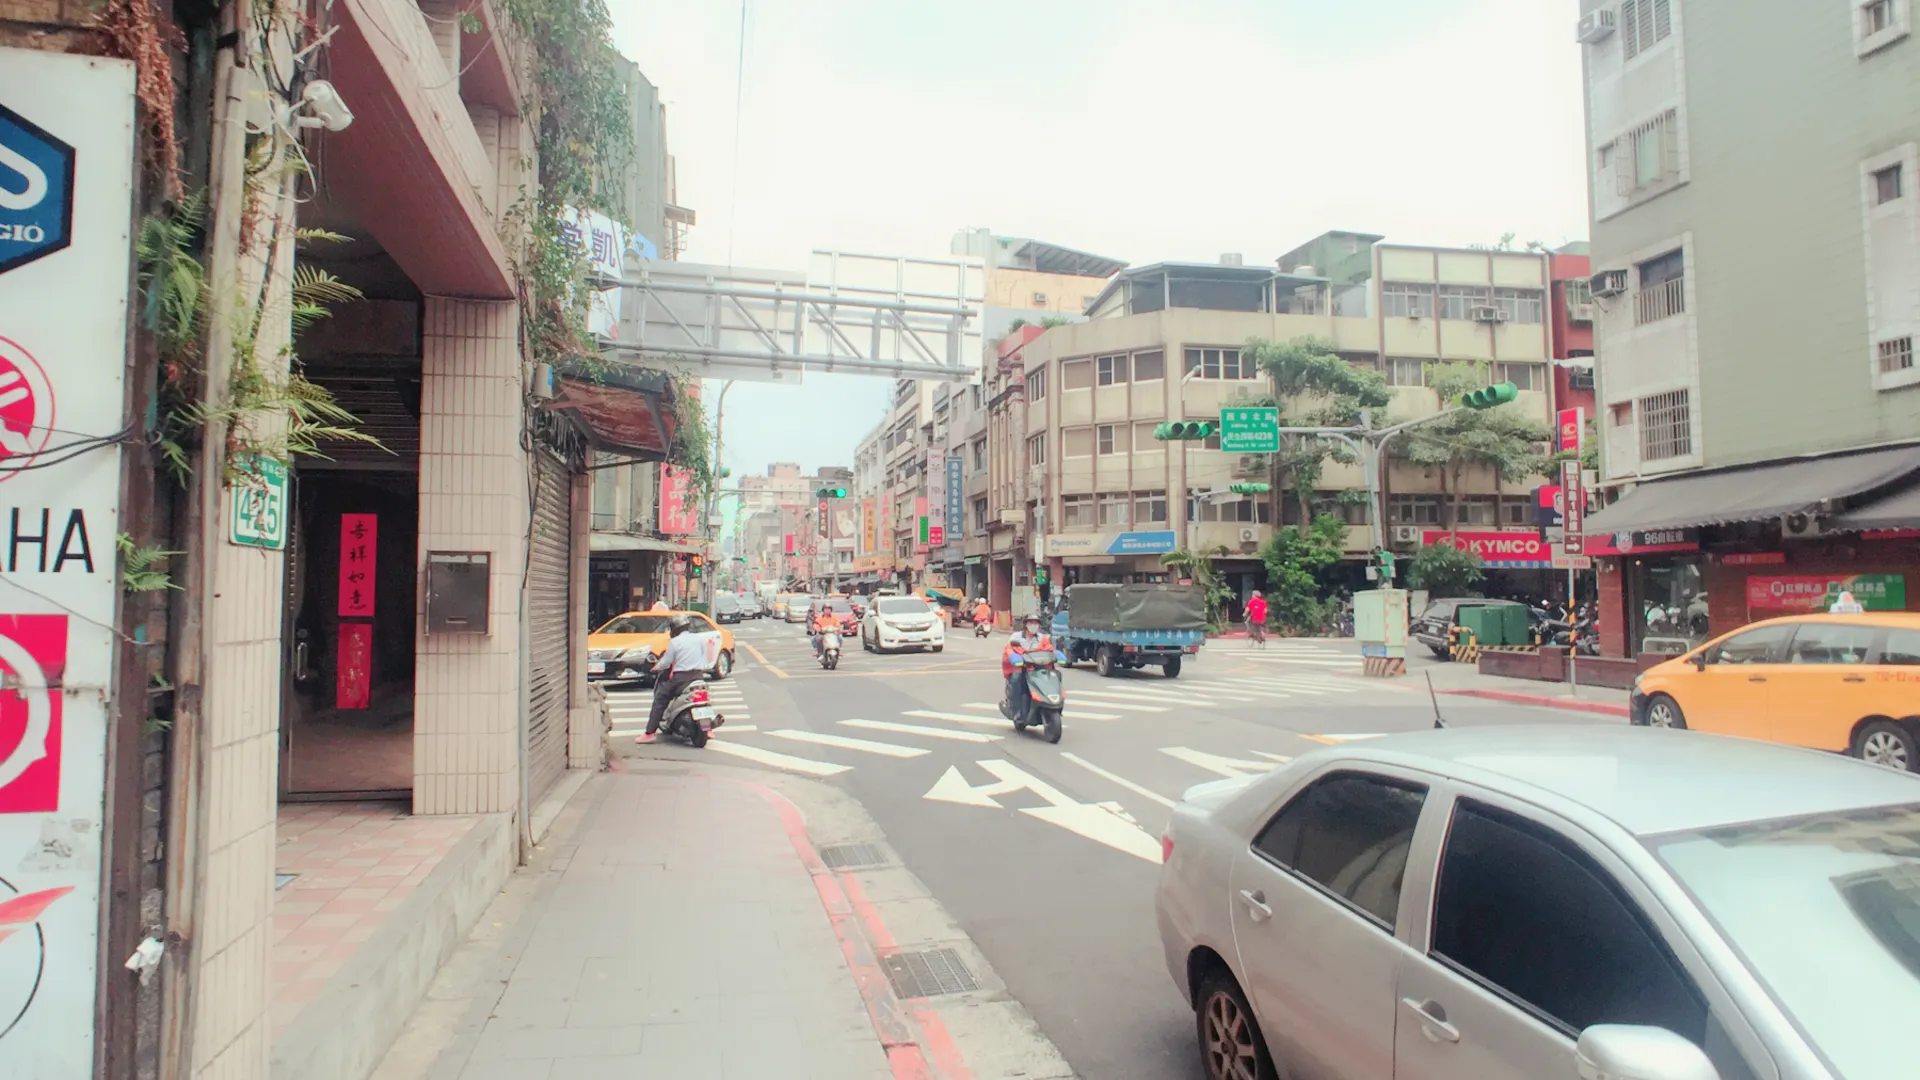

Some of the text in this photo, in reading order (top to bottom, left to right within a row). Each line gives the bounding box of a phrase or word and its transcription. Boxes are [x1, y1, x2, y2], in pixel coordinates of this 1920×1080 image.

[0, 507, 95, 573] HA
[1051, 539, 1091, 547] Panasonic
[1469, 540, 1540, 554] KYMCO
[348, 520, 368, 610] 吉祥如意
